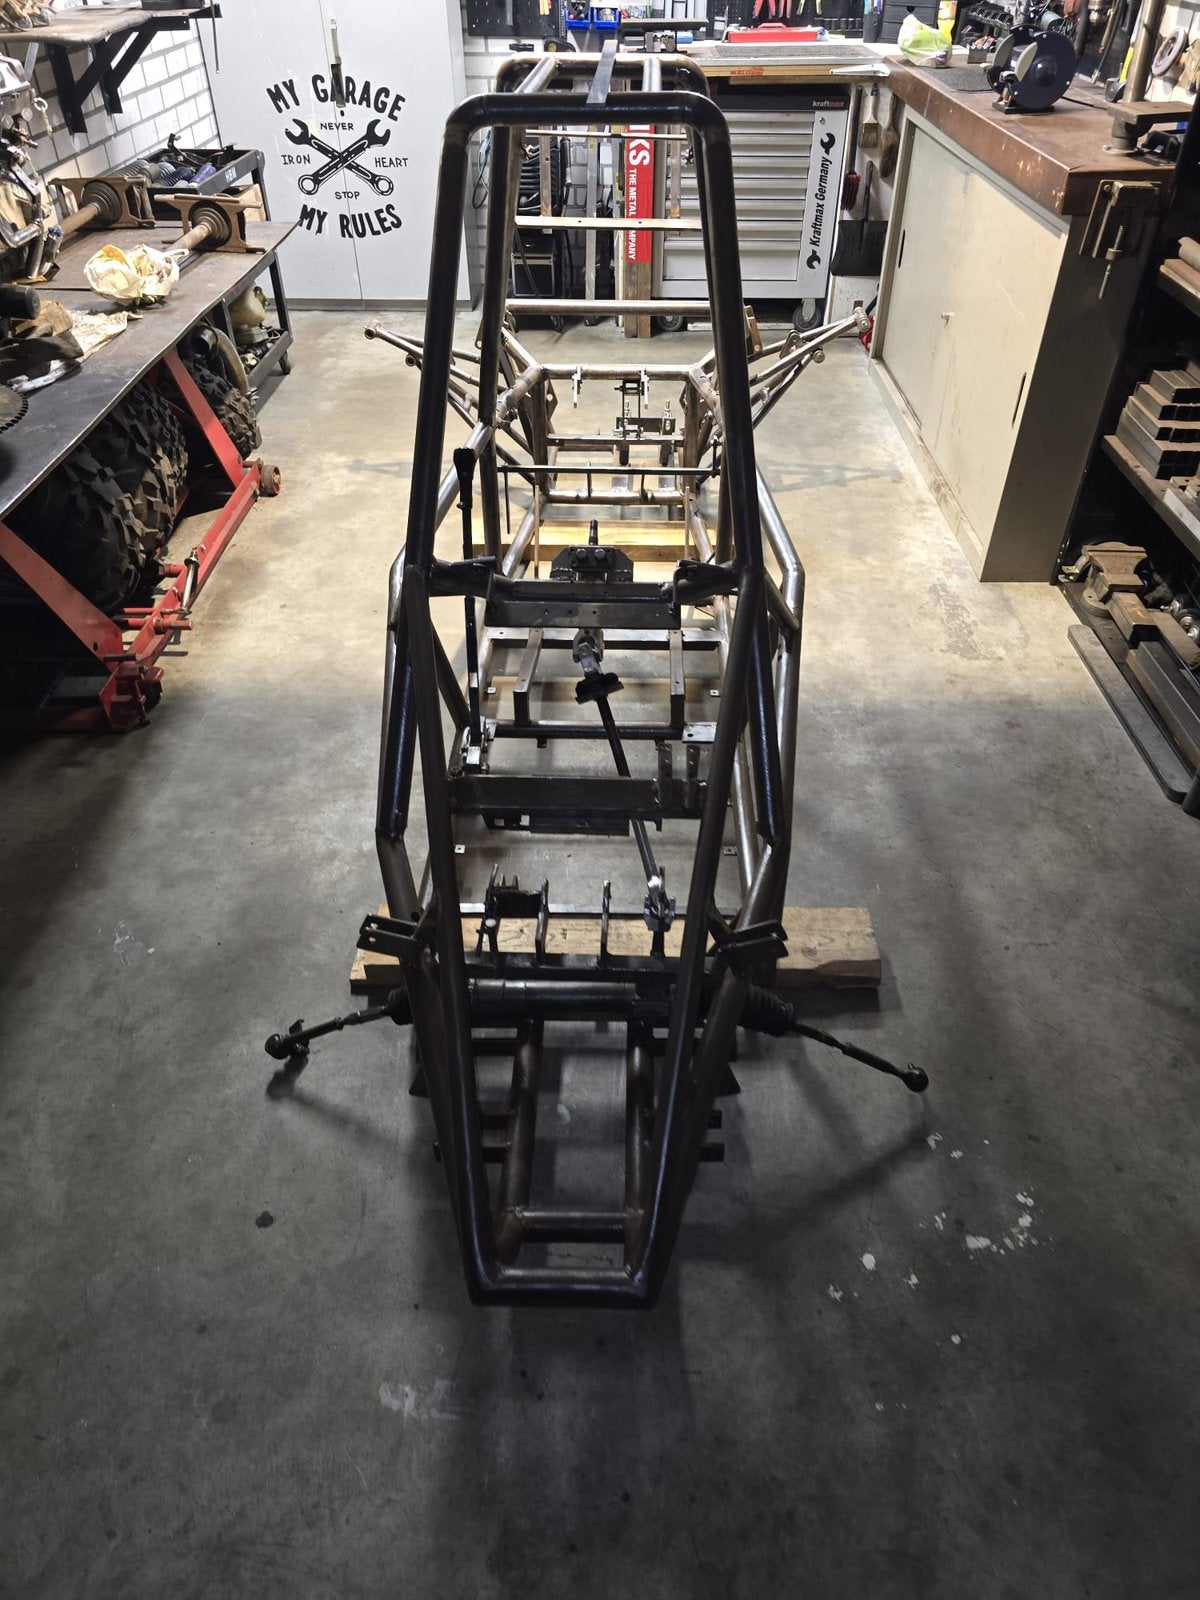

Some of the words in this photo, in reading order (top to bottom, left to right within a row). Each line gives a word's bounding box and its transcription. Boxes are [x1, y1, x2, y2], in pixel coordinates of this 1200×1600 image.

[266, 79, 300, 114] MY
[320, 122, 354, 131] NEVER
[281, 154, 311, 166] IRON
[374, 157, 408, 168] HEART
[629, 168, 637, 186] THE
[814, 156, 832, 202] Germany
[334, 191, 360, 200] STOP
[628, 186, 637, 217] METAL
[299, 204, 328, 235] MY
[339, 203, 402, 238] RULES
[809, 202, 825, 247] Kraftmax
[628, 229, 637, 260] MPANY
